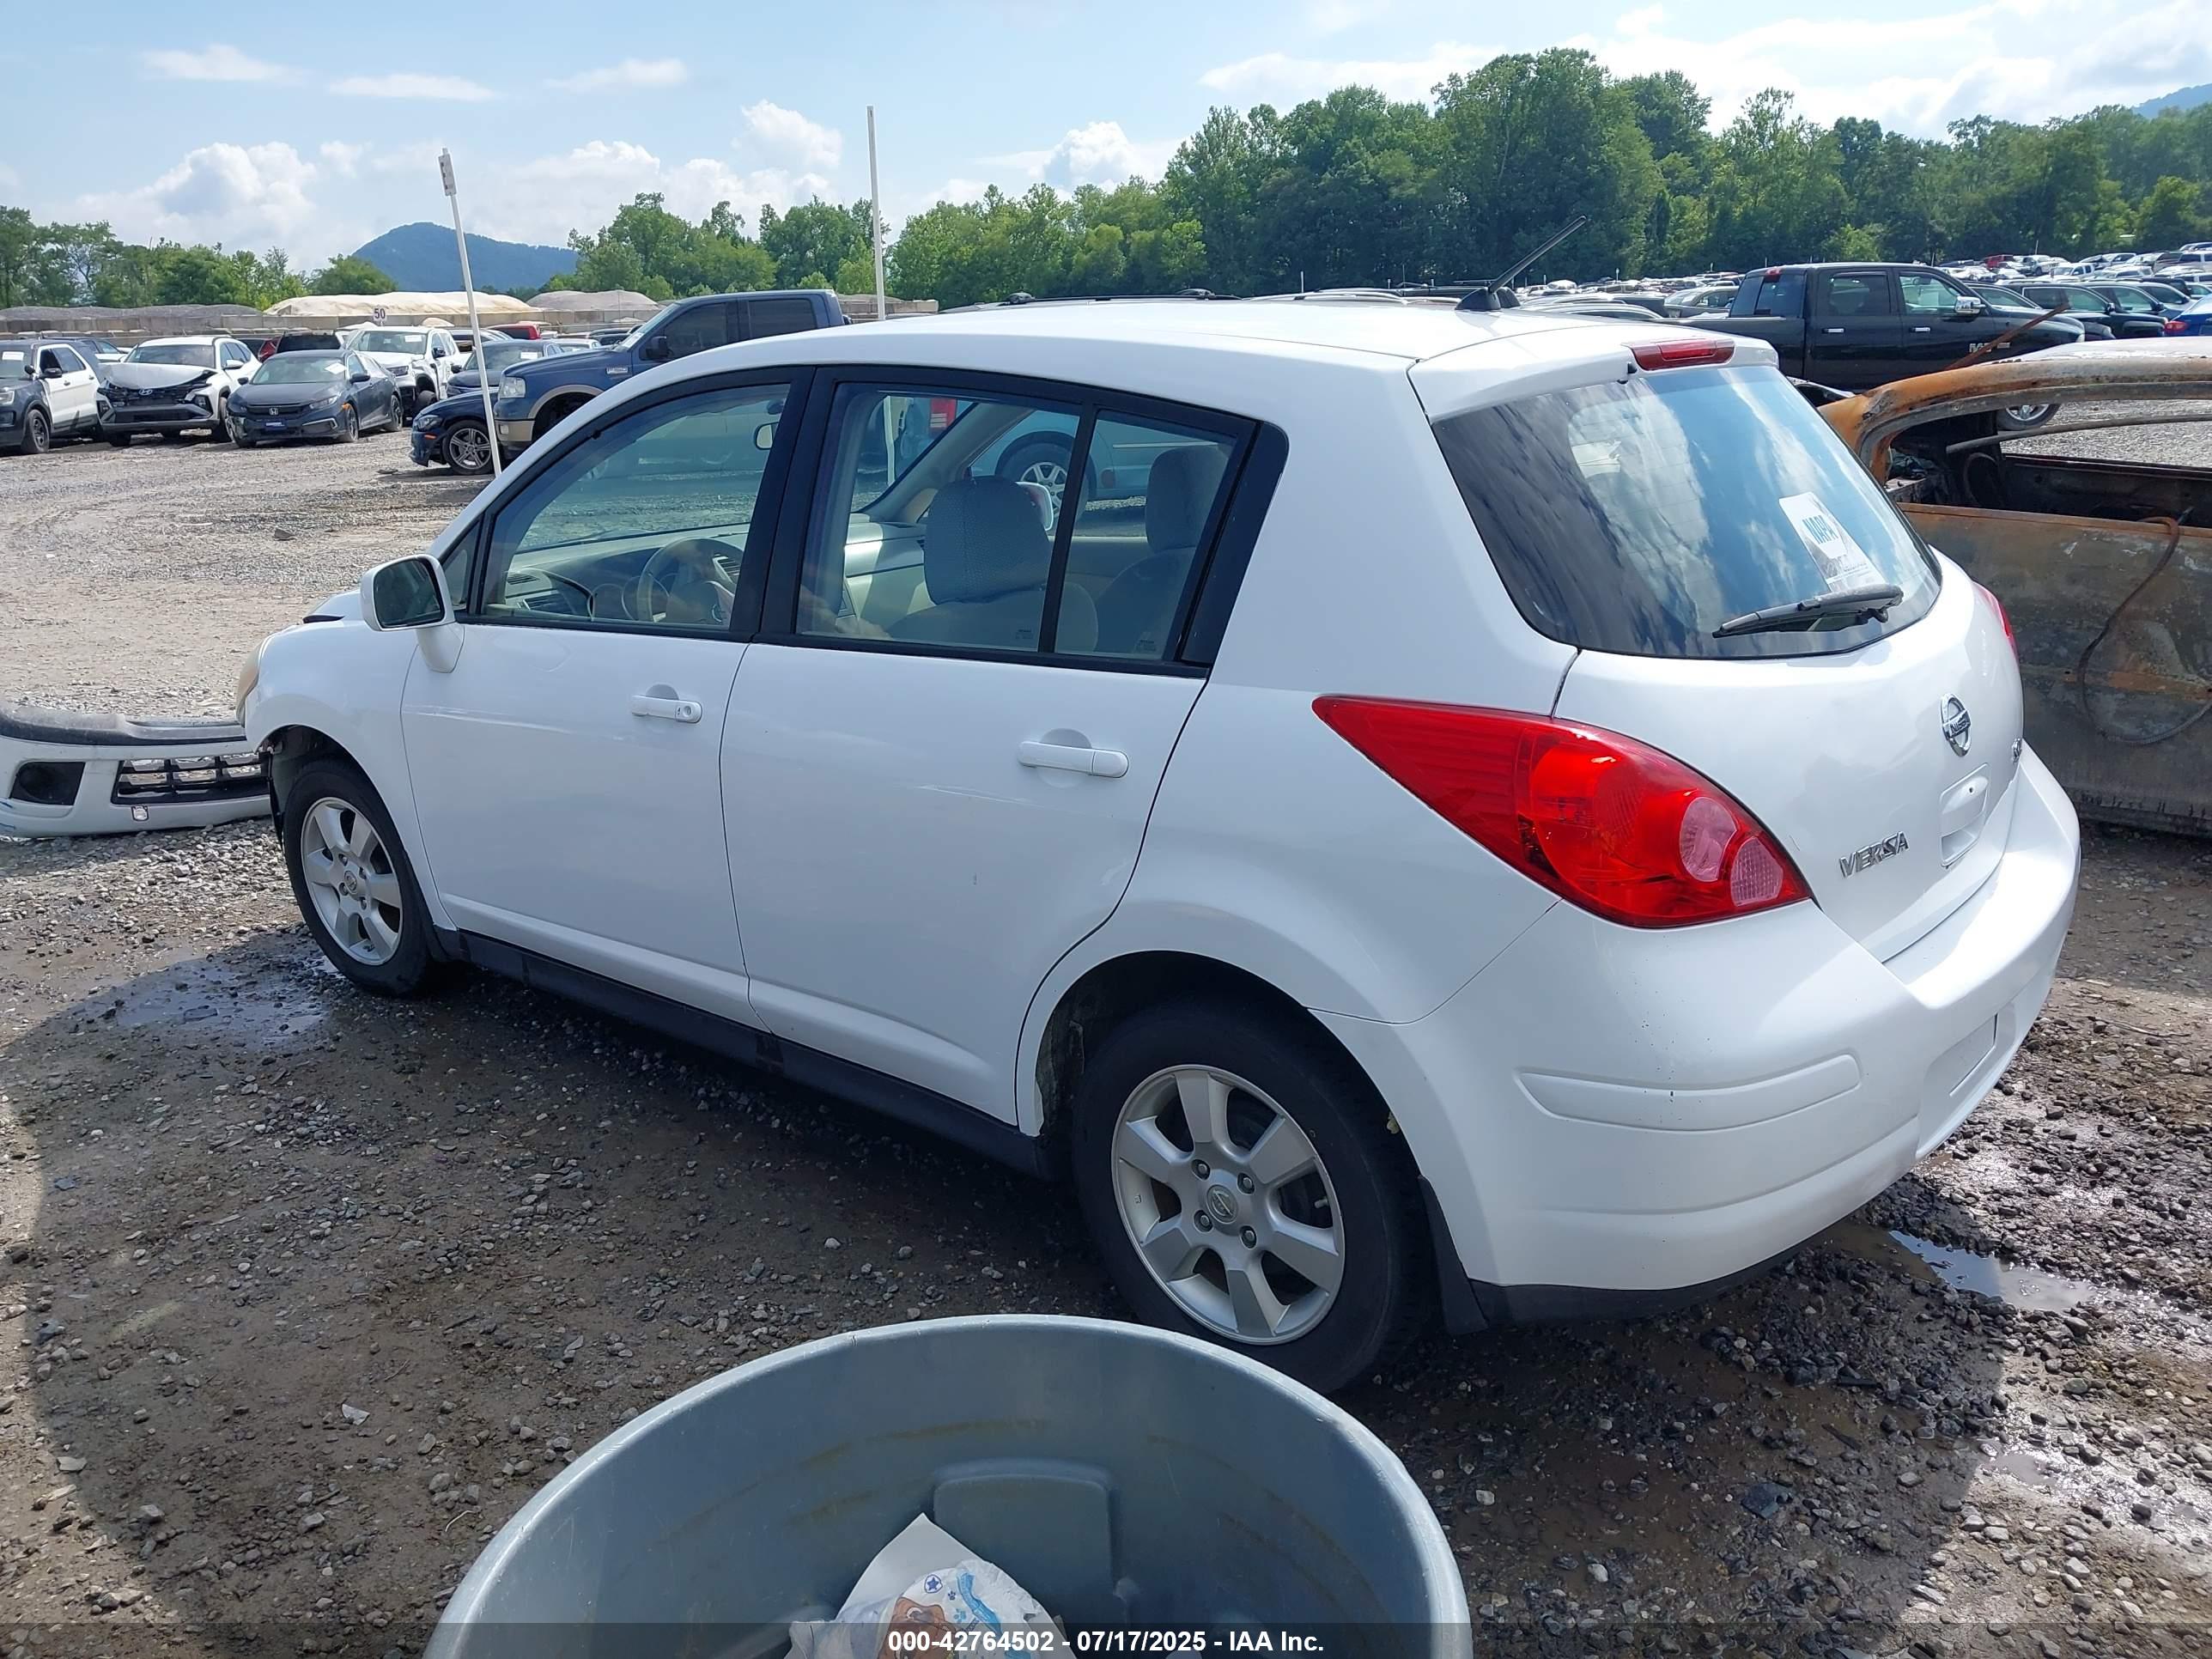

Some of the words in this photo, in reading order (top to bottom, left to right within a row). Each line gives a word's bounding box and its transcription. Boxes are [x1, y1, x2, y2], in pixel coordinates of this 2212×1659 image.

[374, 308, 386, 319] 50
[1802, 514, 1839, 544] NAPA
[1838, 831, 1910, 878] VERSA
